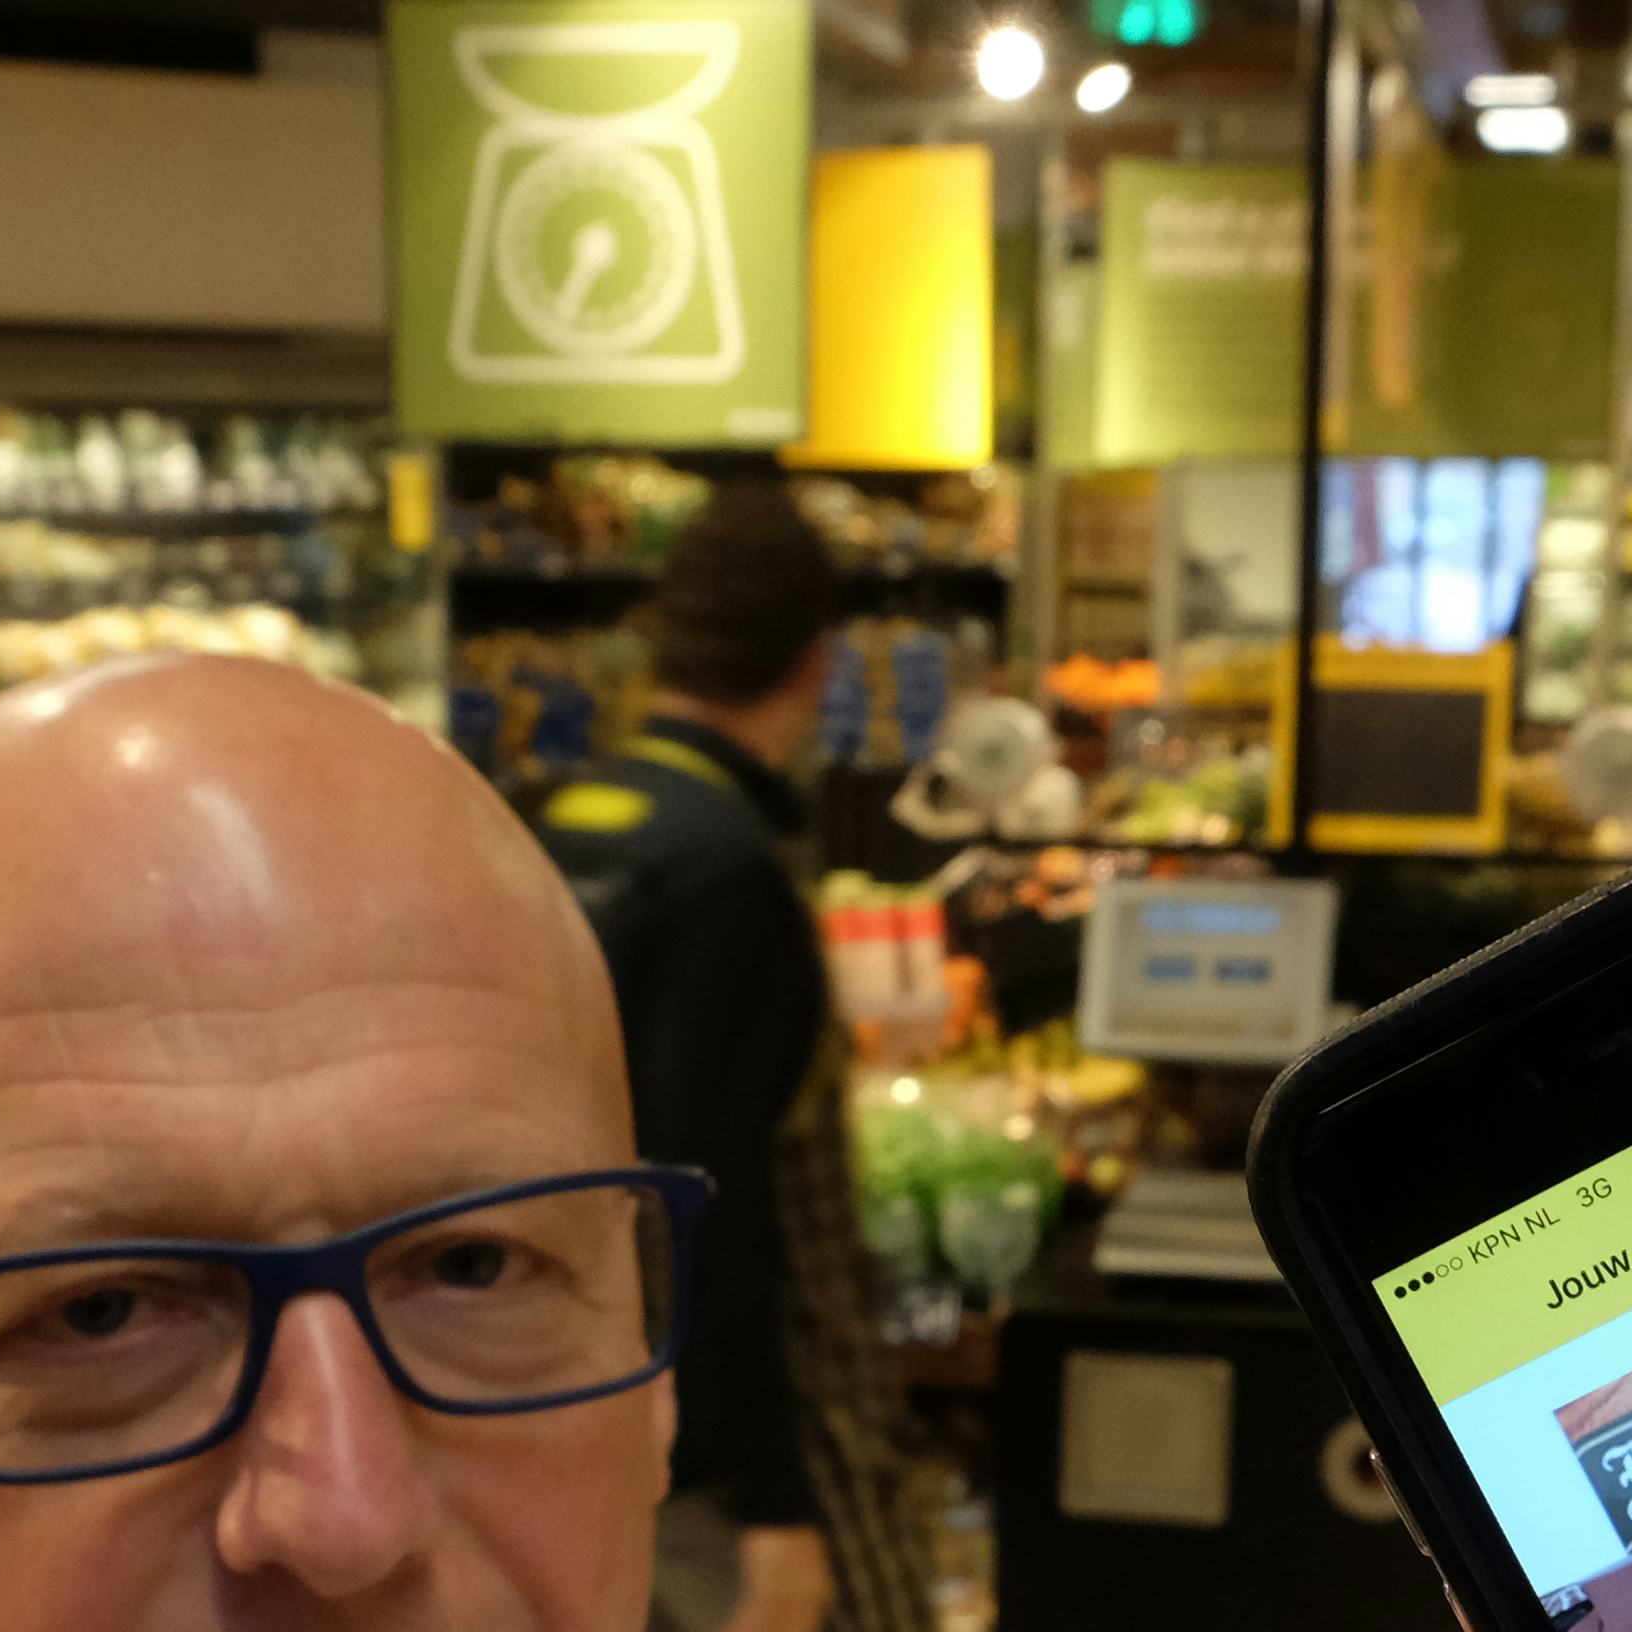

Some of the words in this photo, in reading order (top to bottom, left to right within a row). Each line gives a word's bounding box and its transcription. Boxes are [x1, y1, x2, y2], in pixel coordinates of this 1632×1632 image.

[1468, 1224, 1521, 1263] KPN
[1524, 1206, 1561, 1236] NL
[1576, 1177, 1614, 1208] 3G
[1547, 1249, 1631, 1310] Jouw
